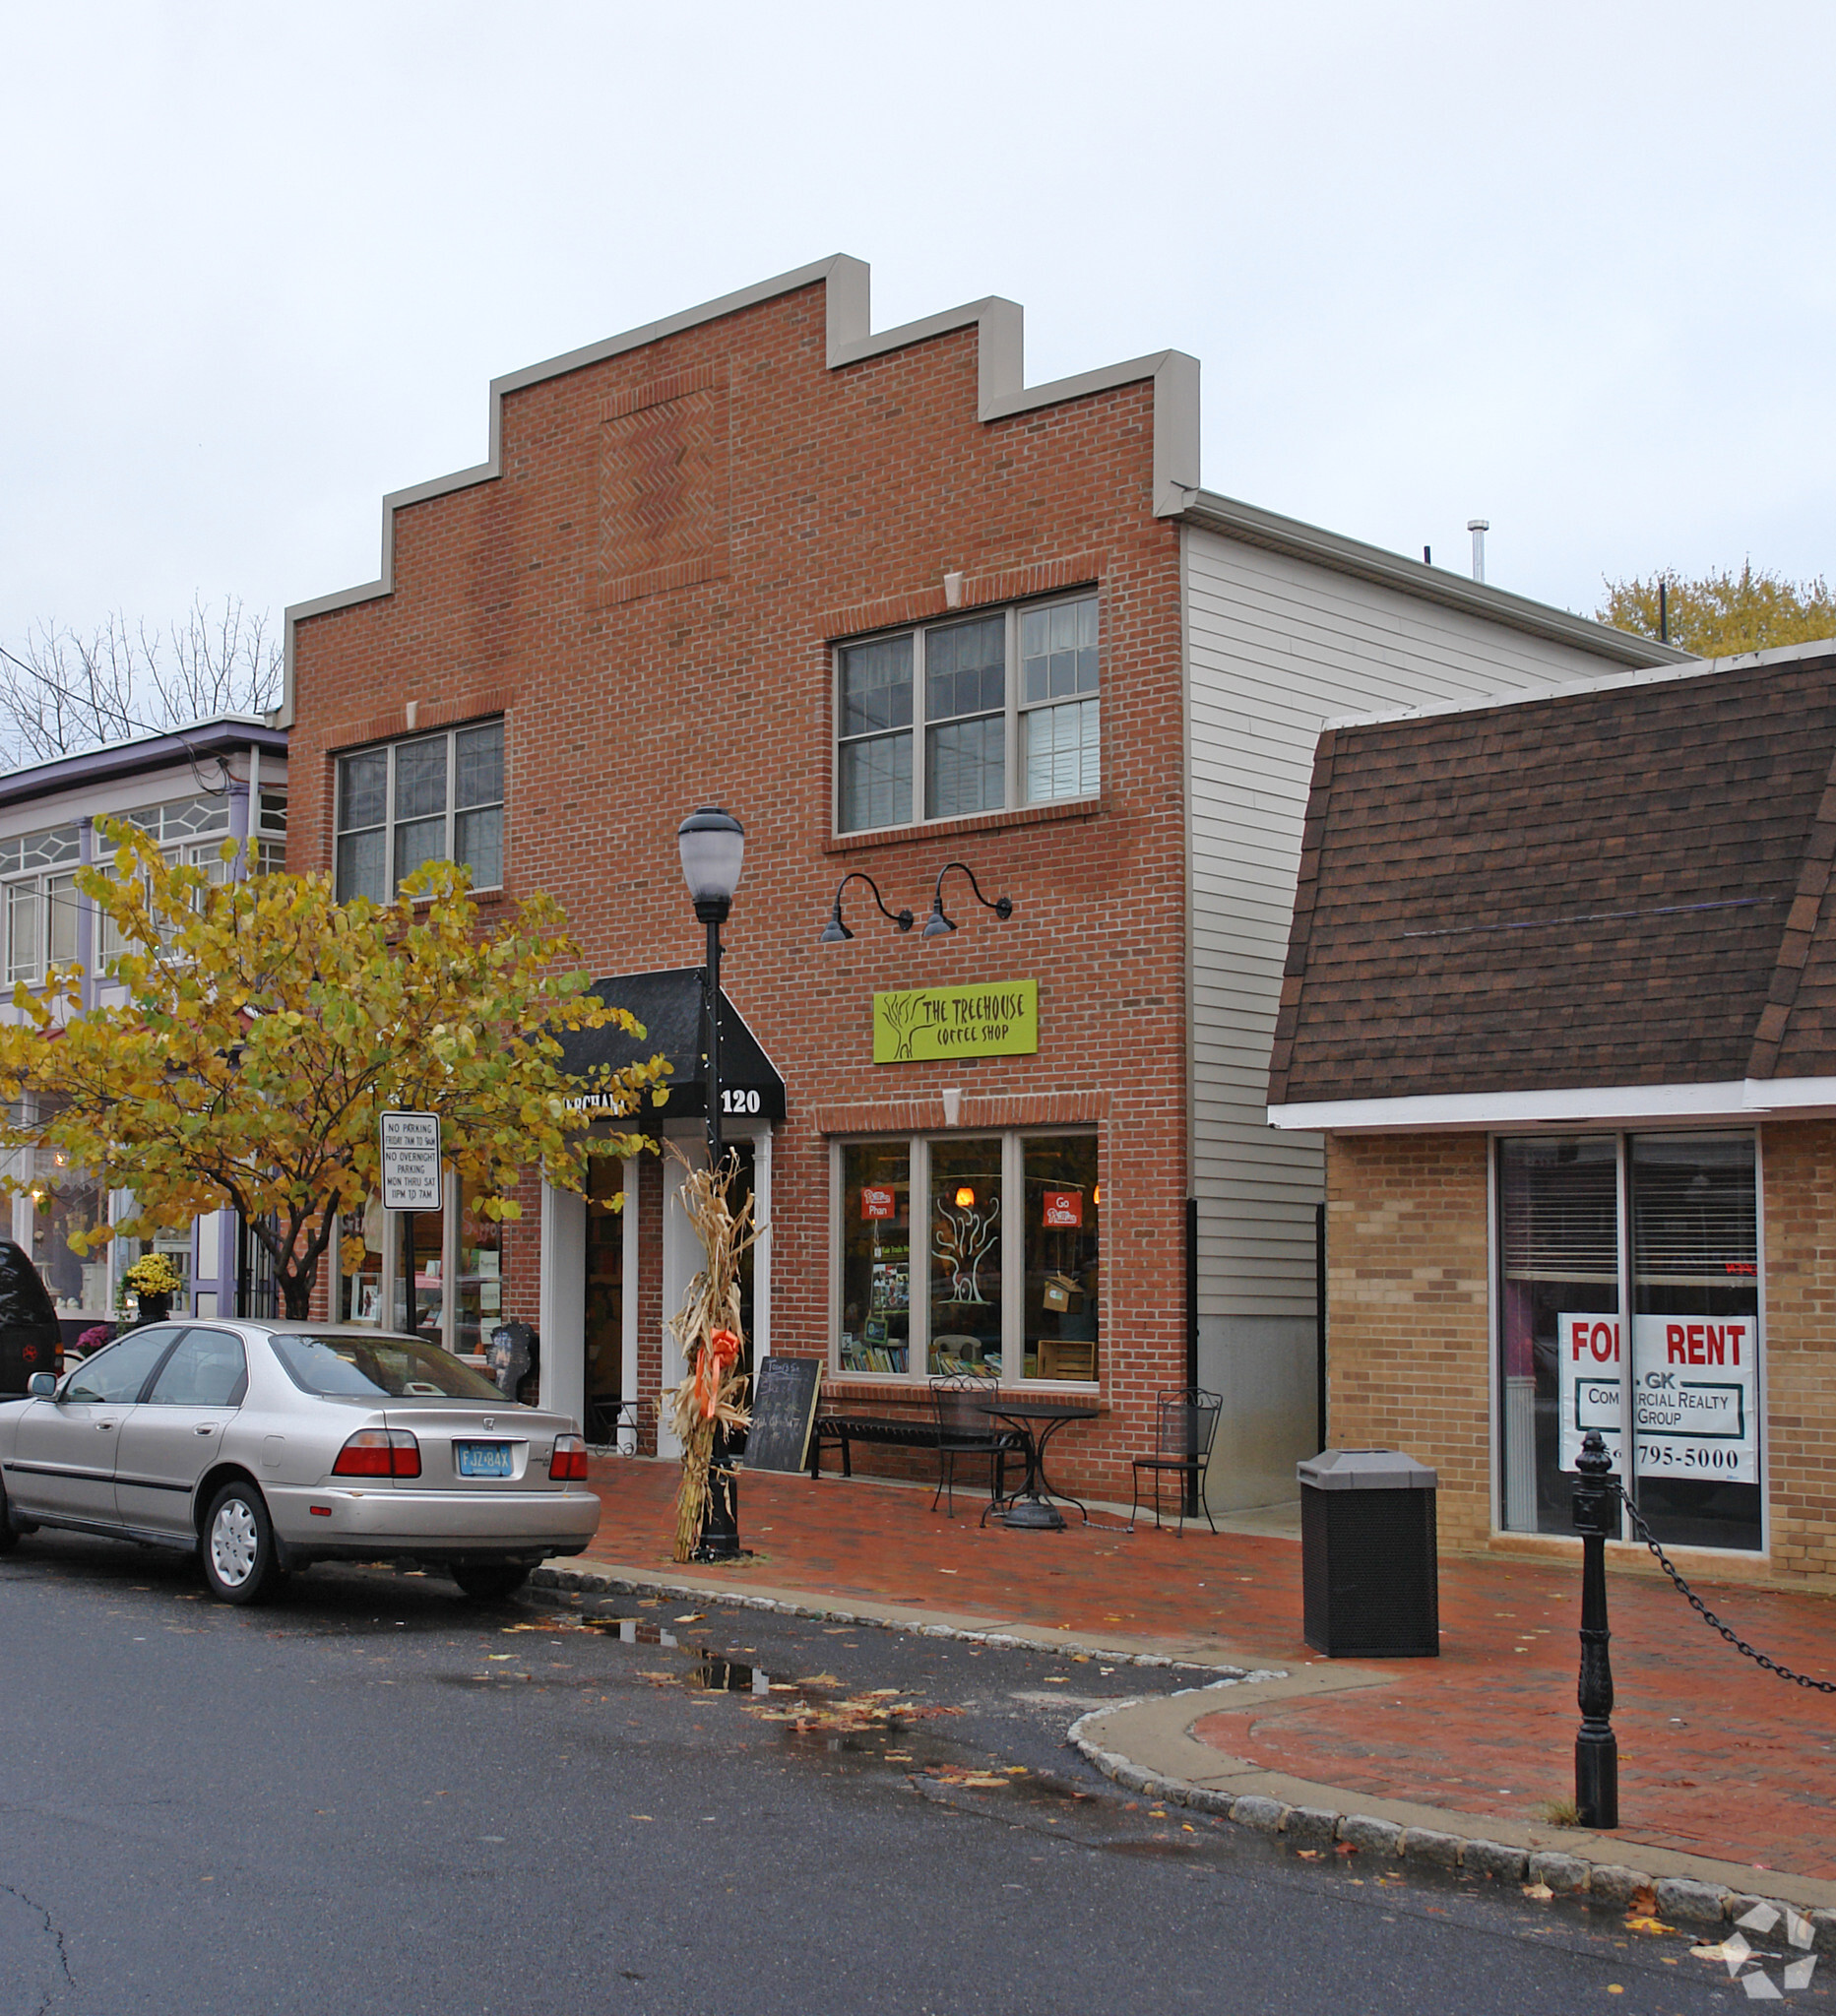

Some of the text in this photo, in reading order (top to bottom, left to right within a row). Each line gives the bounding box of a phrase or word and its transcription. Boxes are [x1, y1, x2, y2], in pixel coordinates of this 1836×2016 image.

[922, 994, 1025, 1026] THE TREEHOUSE
[937, 1024, 1009, 1045] COFFEE SHOP
[723, 1090, 761, 1113] 120
[388, 1123, 432, 1134] NO PARKING
[385, 1136, 402, 1145] FRIDAY
[416, 1137, 423, 1146] TO
[386, 1152, 436, 1162] NO OVERNIGHT
[397, 1165, 425, 1174] PARKING
[387, 1176, 435, 1186] MON THRU SAT
[392, 1189, 432, 1200] 11PM TO 7AM
[1056, 1197, 1070, 1208] Go
[1667, 1324, 1745, 1365] RENT
[1645, 1371, 1676, 1389] GK
[1638, 1445, 1739, 1470] 795-5000
